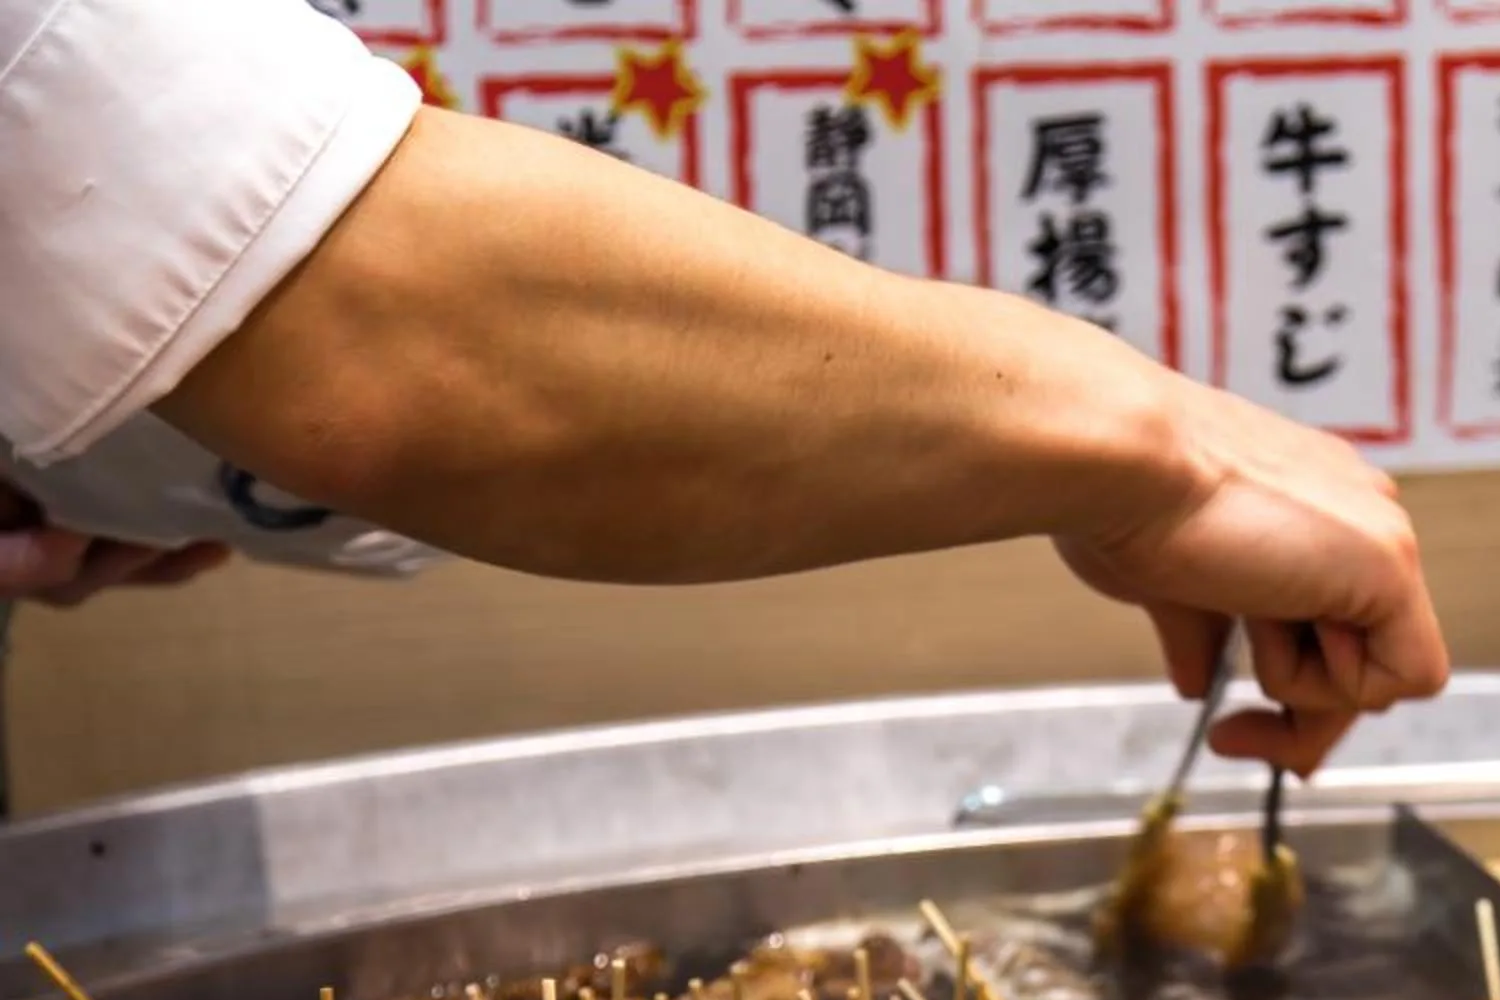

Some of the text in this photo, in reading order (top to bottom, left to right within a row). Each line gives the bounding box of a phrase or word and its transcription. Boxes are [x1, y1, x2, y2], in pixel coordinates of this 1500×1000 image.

[805, 104, 872, 262] 静岡
[1019, 112, 1120, 331] 厚揚
[1261, 104, 1350, 388] 牛すじ
